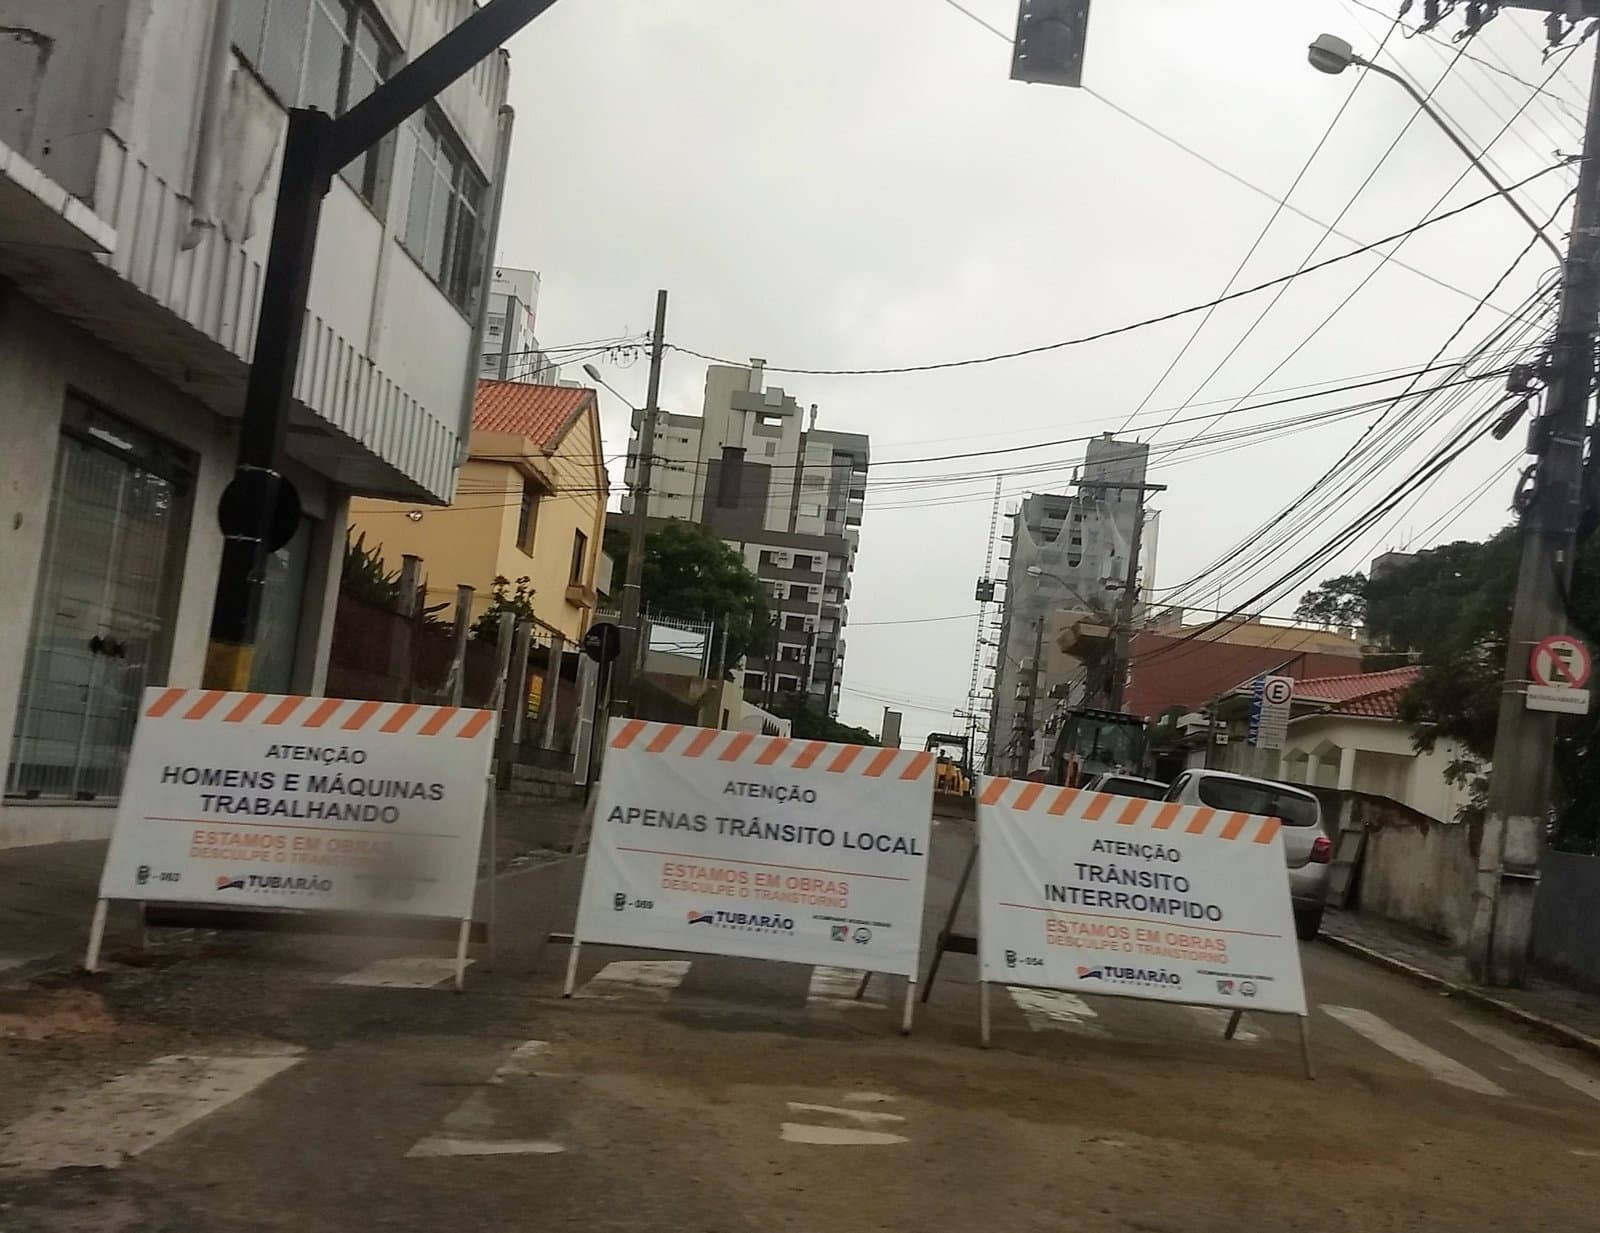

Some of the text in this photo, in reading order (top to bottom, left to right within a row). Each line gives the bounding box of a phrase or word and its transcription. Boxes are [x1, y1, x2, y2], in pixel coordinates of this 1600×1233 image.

[1272, 685, 1284, 699] E
[265, 744, 368, 766] ATENÇÃO
[160, 765, 445, 801] HOMENS E MÁQUINAS
[723, 780, 817, 804] ATENÇÃO
[200, 794, 400, 824] TRABALHANDO
[192, 830, 287, 849] ESTAMOS
[292, 837, 321, 851] EM
[607, 805, 924, 856] APENAS TRÂNSITO LOCAL
[1092, 839, 1181, 863] ATENÇÃO
[249, 874, 333, 892] TUBARÃO
[663, 862, 849, 896] ESTAMOS EM OBRAS
[1074, 863, 1190, 893] TRÂNSITO
[662, 878, 849, 909] DESCULPE O TRANSTORNO
[1044, 884, 1222, 922] INTERROMPIDO
[716, 910, 794, 930] TUBARÃO
[1046, 919, 1227, 951] ESTAMOS EM OBRAS
[1046, 934, 1228, 964] DESCULPE O TRANSTORNO
[1103, 966, 1181, 985] TUBARÃO
